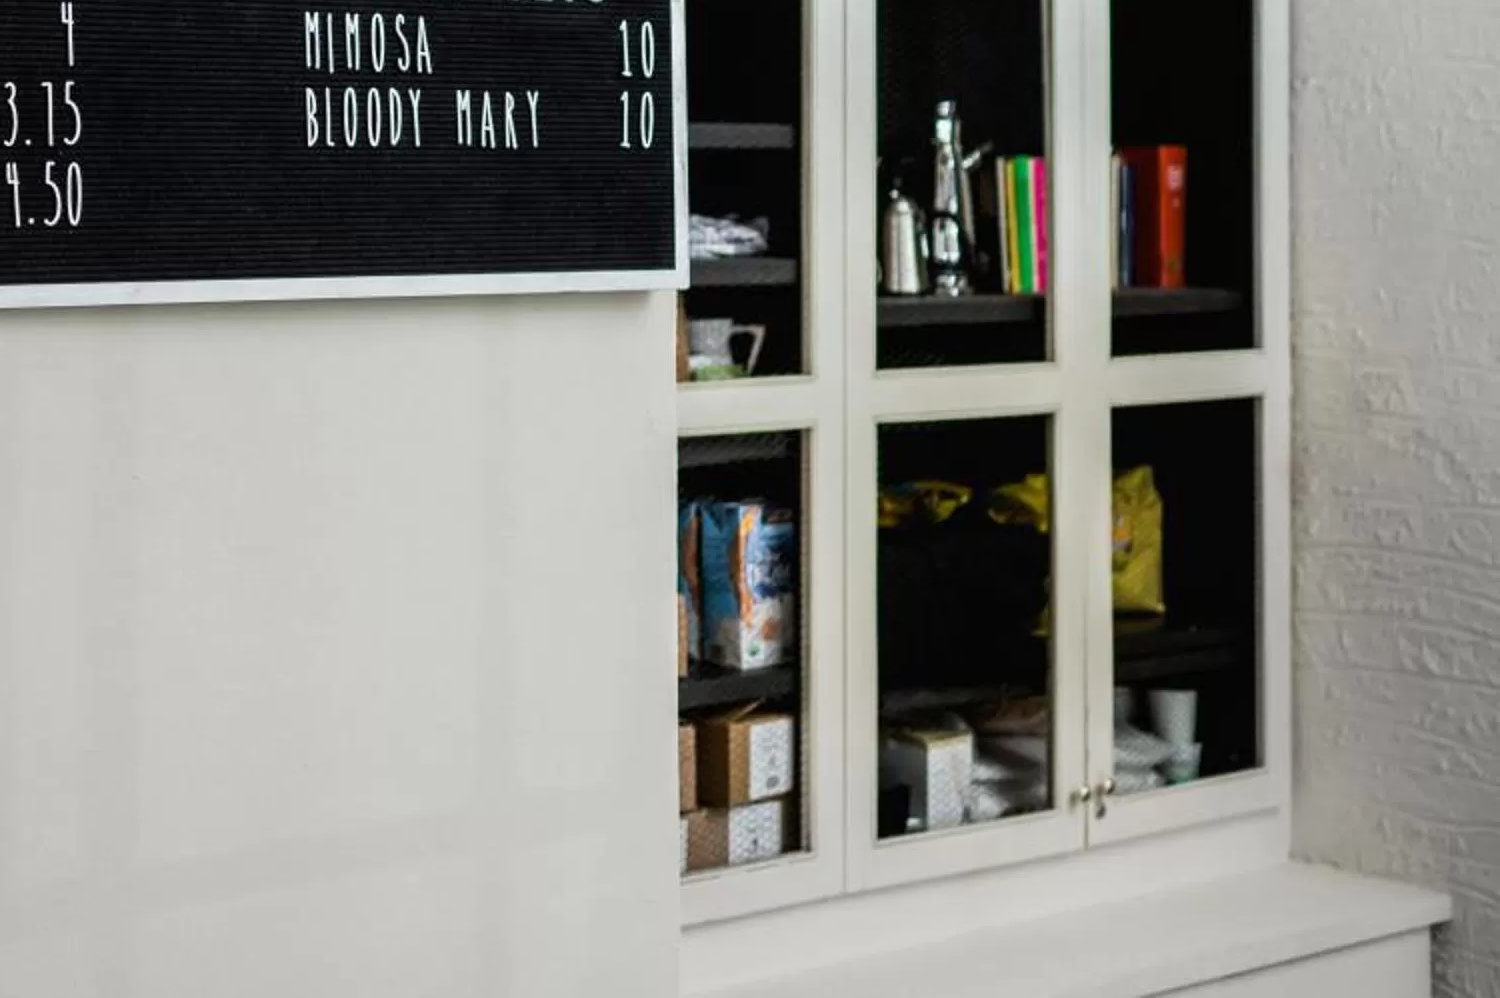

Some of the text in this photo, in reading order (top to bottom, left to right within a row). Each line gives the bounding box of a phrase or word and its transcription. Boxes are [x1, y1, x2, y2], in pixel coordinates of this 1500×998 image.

[60, 1, 75, 67] 4
[304, 11, 655, 79] MIMOSA 10
[3, 80, 82, 147] 3.75
[305, 86, 655, 150] BLOODY MARY 10
[5, 160, 83, 228] 4.50
